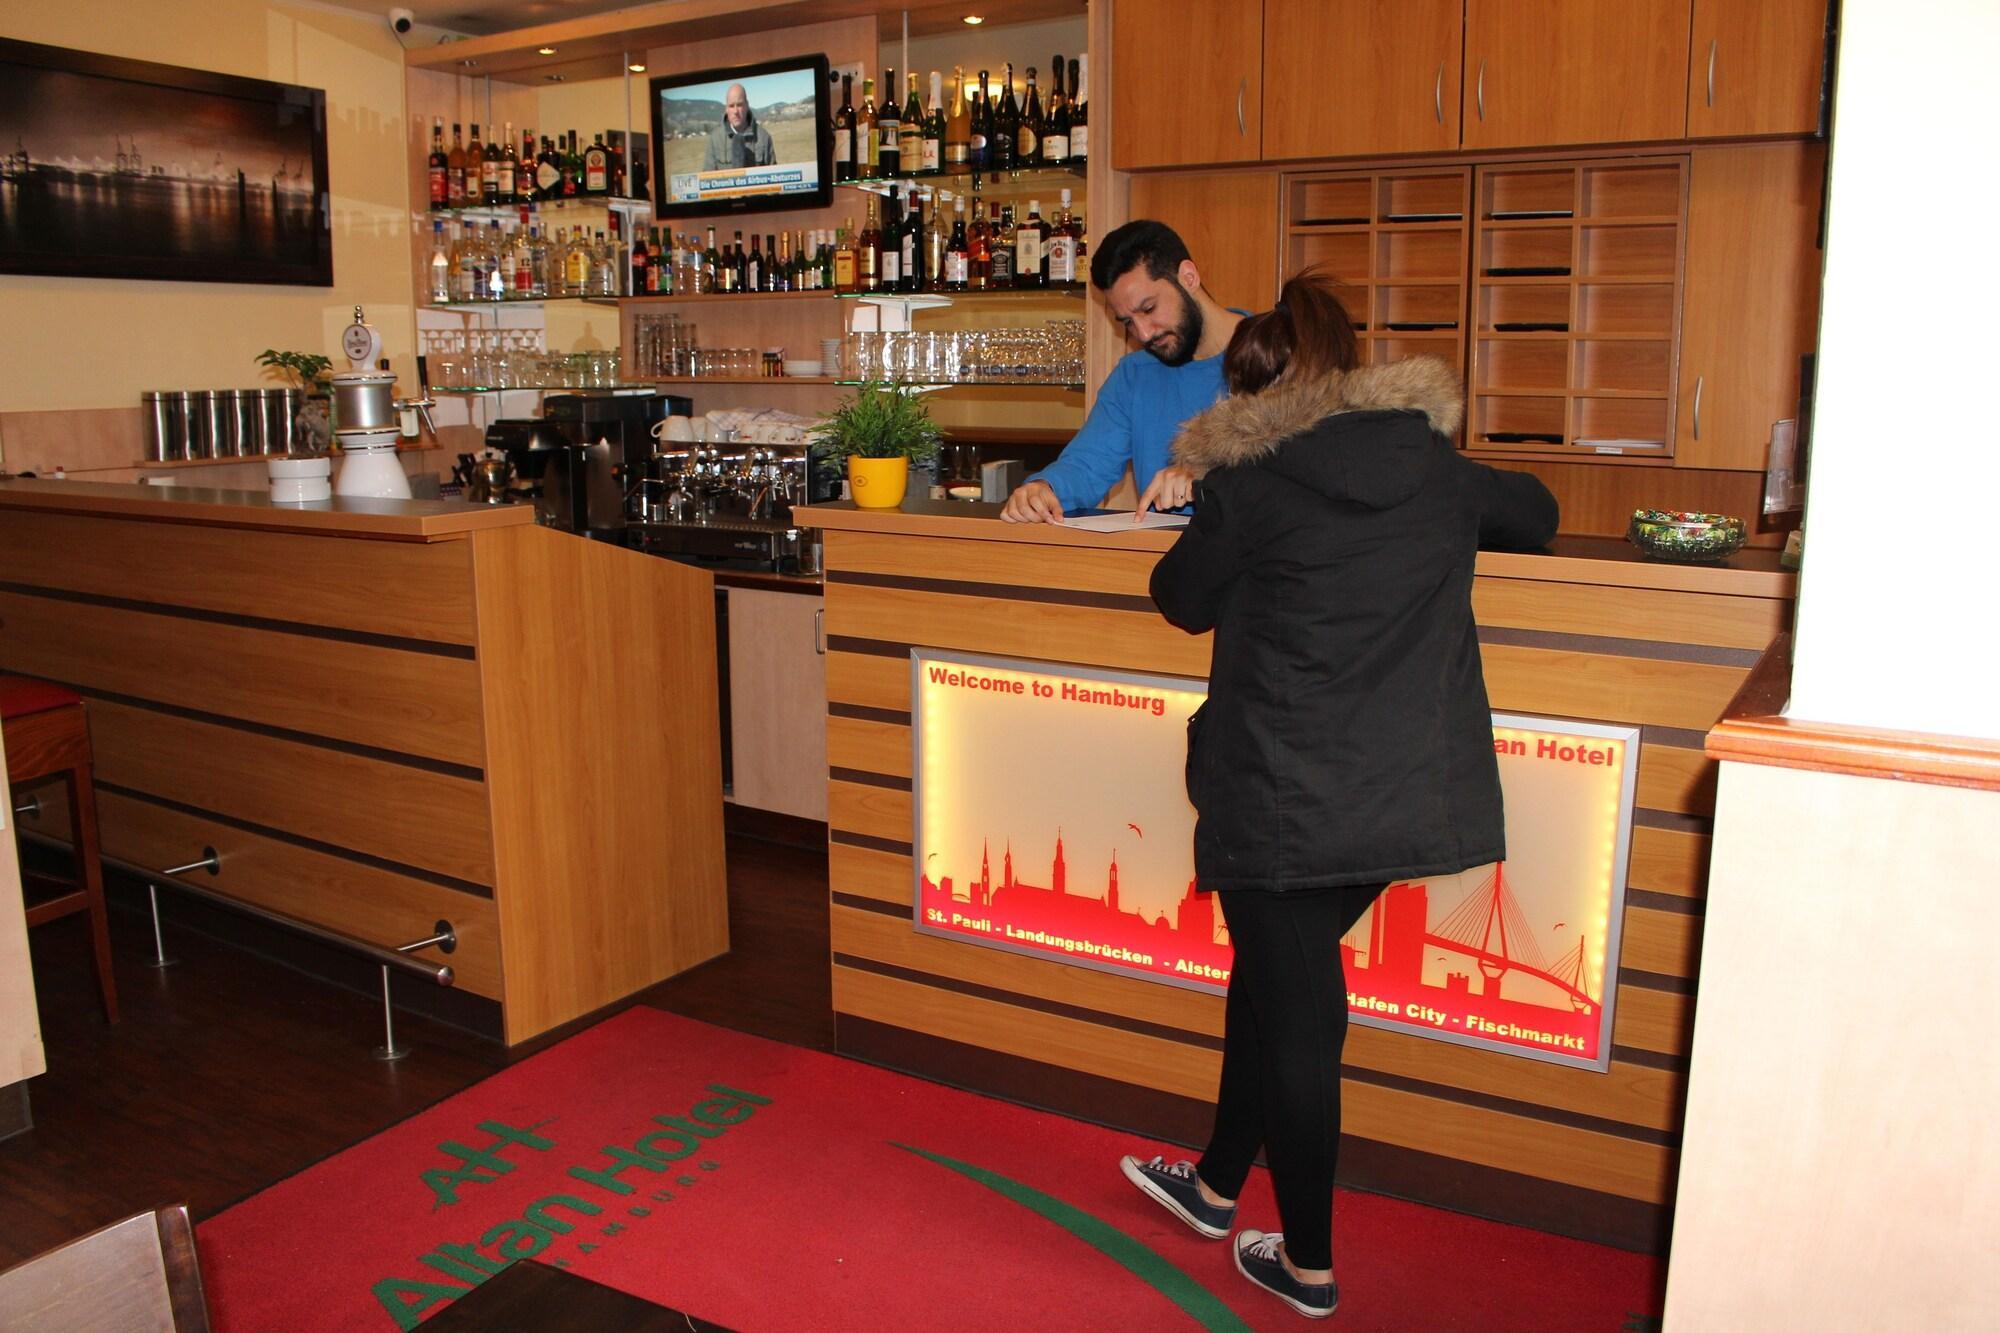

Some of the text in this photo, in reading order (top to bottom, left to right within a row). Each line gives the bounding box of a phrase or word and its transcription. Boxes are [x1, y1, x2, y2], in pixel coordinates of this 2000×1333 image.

[929, 667, 1165, 716] Welcome to Hamburg
[1536, 739, 1614, 766] Hotel
[927, 908, 948, 923] St.
[952, 913, 991, 932] Pauli
[1006, 924, 1153, 966] Landungsbrücken
[1175, 959, 1231, 981] Alster
[1406, 1004, 1447, 1026] City
[1466, 1015, 1585, 1050] Fischmarkt
[566, 1083, 774, 1196] Hotel
